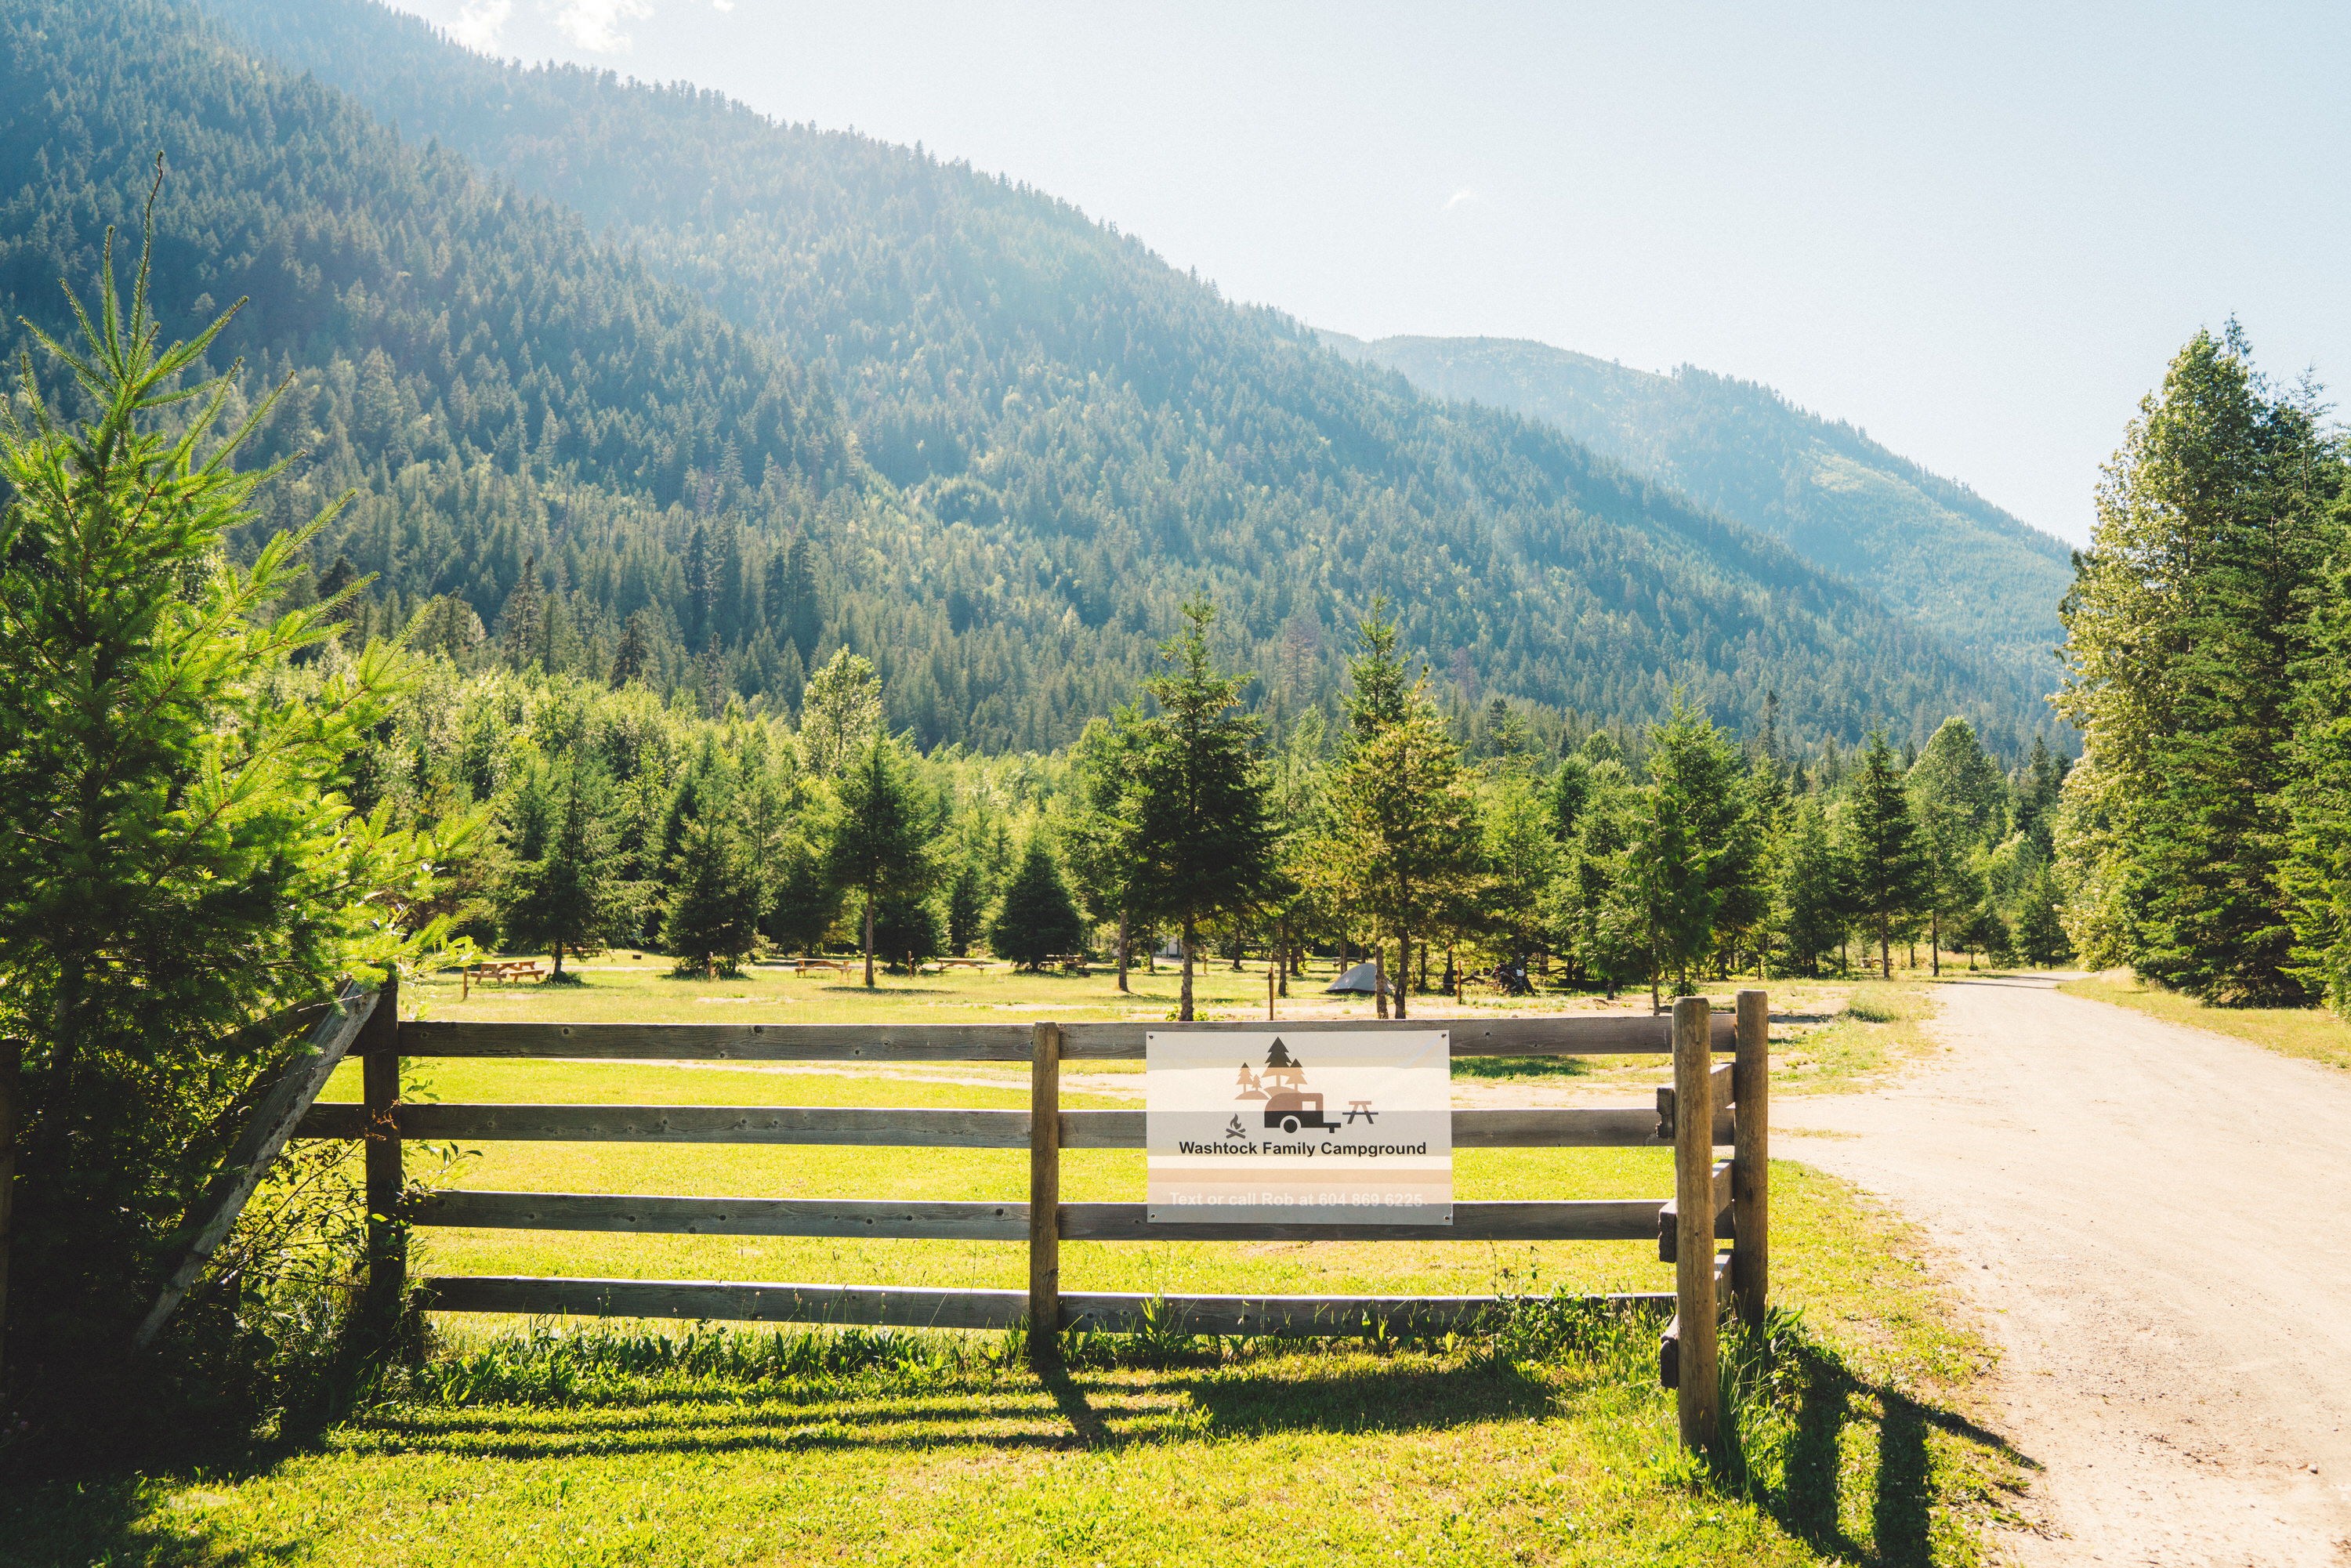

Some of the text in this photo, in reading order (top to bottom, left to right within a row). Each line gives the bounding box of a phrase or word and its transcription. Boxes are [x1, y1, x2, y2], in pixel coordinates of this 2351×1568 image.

[1179, 1142, 1426, 1157] Washtock Family Campground
[1169, 1192, 1203, 1206] Text
[1208, 1196, 1224, 1206] or
[1229, 1193, 1255, 1206] call
[1262, 1193, 1294, 1206] Rob
[1299, 1193, 1314, 1206] at
[1319, 1193, 1347, 1207] 604
[1352, 1193, 1380, 1207] 869
